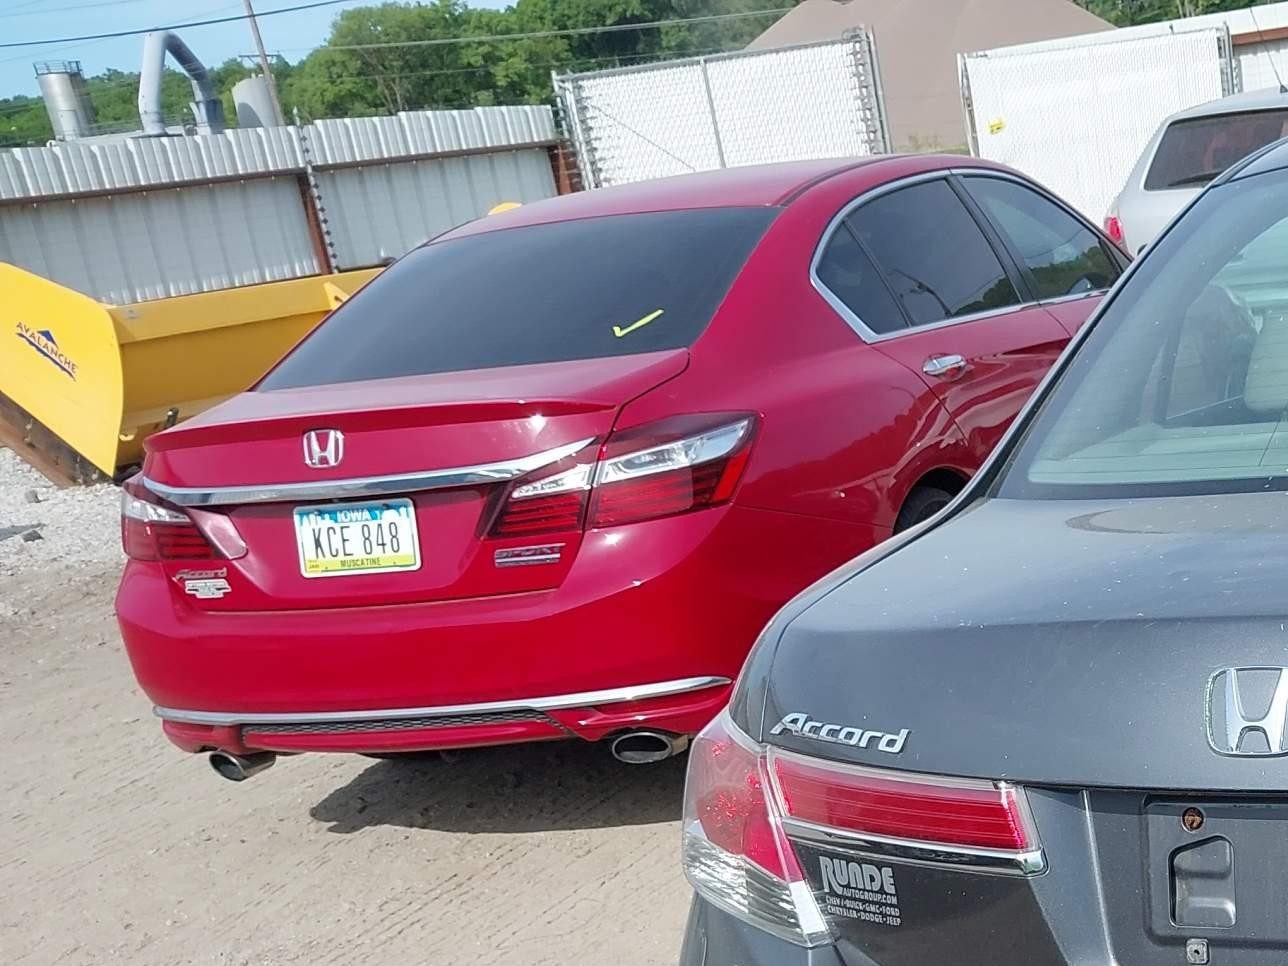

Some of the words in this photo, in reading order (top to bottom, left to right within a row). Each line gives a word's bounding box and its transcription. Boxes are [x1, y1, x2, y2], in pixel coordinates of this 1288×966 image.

[16, 321, 78, 374] AVALANCHE
[336, 508, 372, 523] IOWA
[312, 525, 354, 559] KCE
[361, 521, 400, 555] 848
[339, 557, 381, 568] MUSCATINE
[769, 712, 911, 754] Accord
[818, 855, 896, 896] RUNDE
[842, 887, 898, 905] AUTOGROUP.COM
